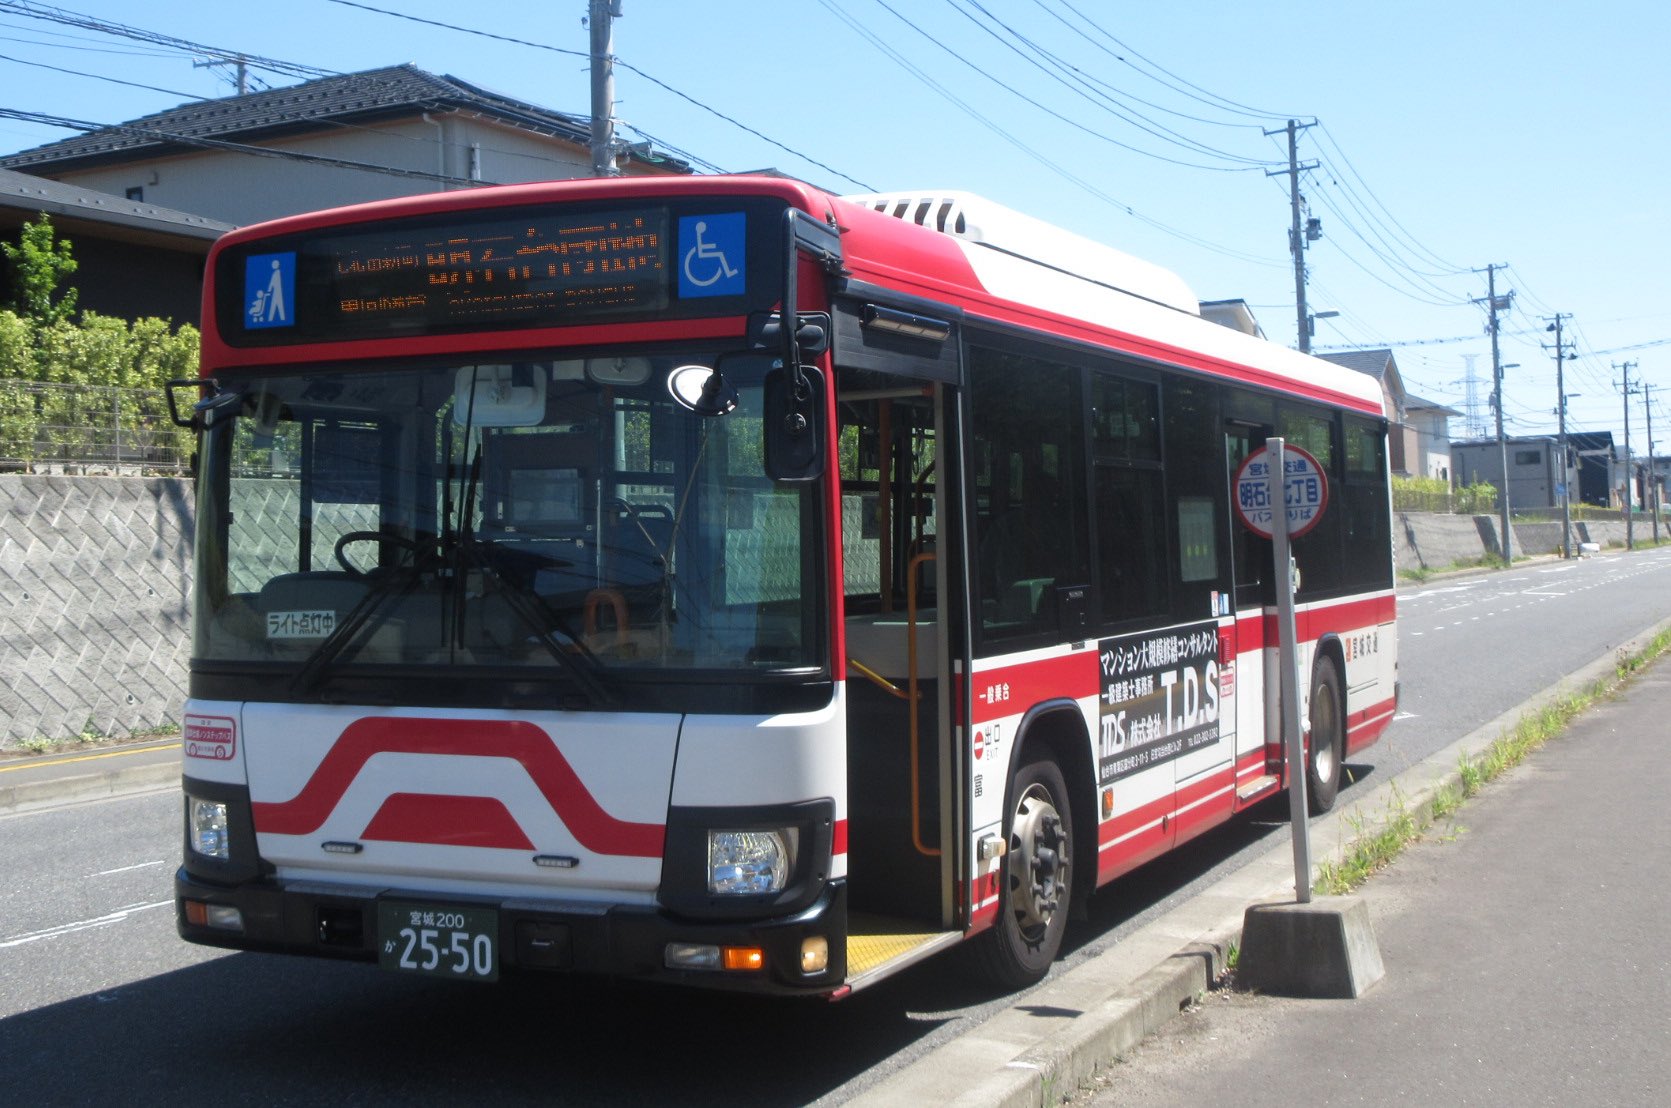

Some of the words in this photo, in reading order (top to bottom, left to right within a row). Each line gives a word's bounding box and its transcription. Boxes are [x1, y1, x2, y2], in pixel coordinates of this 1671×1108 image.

[1248, 459, 1307, 477] 宮交通
[1240, 478, 1319, 508] 明石七丁目
[1251, 508, 1313, 523] バスりば
[269, 612, 335, 635] ライト点灯中
[979, 682, 1010, 704] 一般乗合
[1160, 659, 1219, 736] T.D.S
[984, 724, 1001, 746] 出口
[986, 747, 999, 761] EXIT
[399, 927, 493, 976] 25-50
